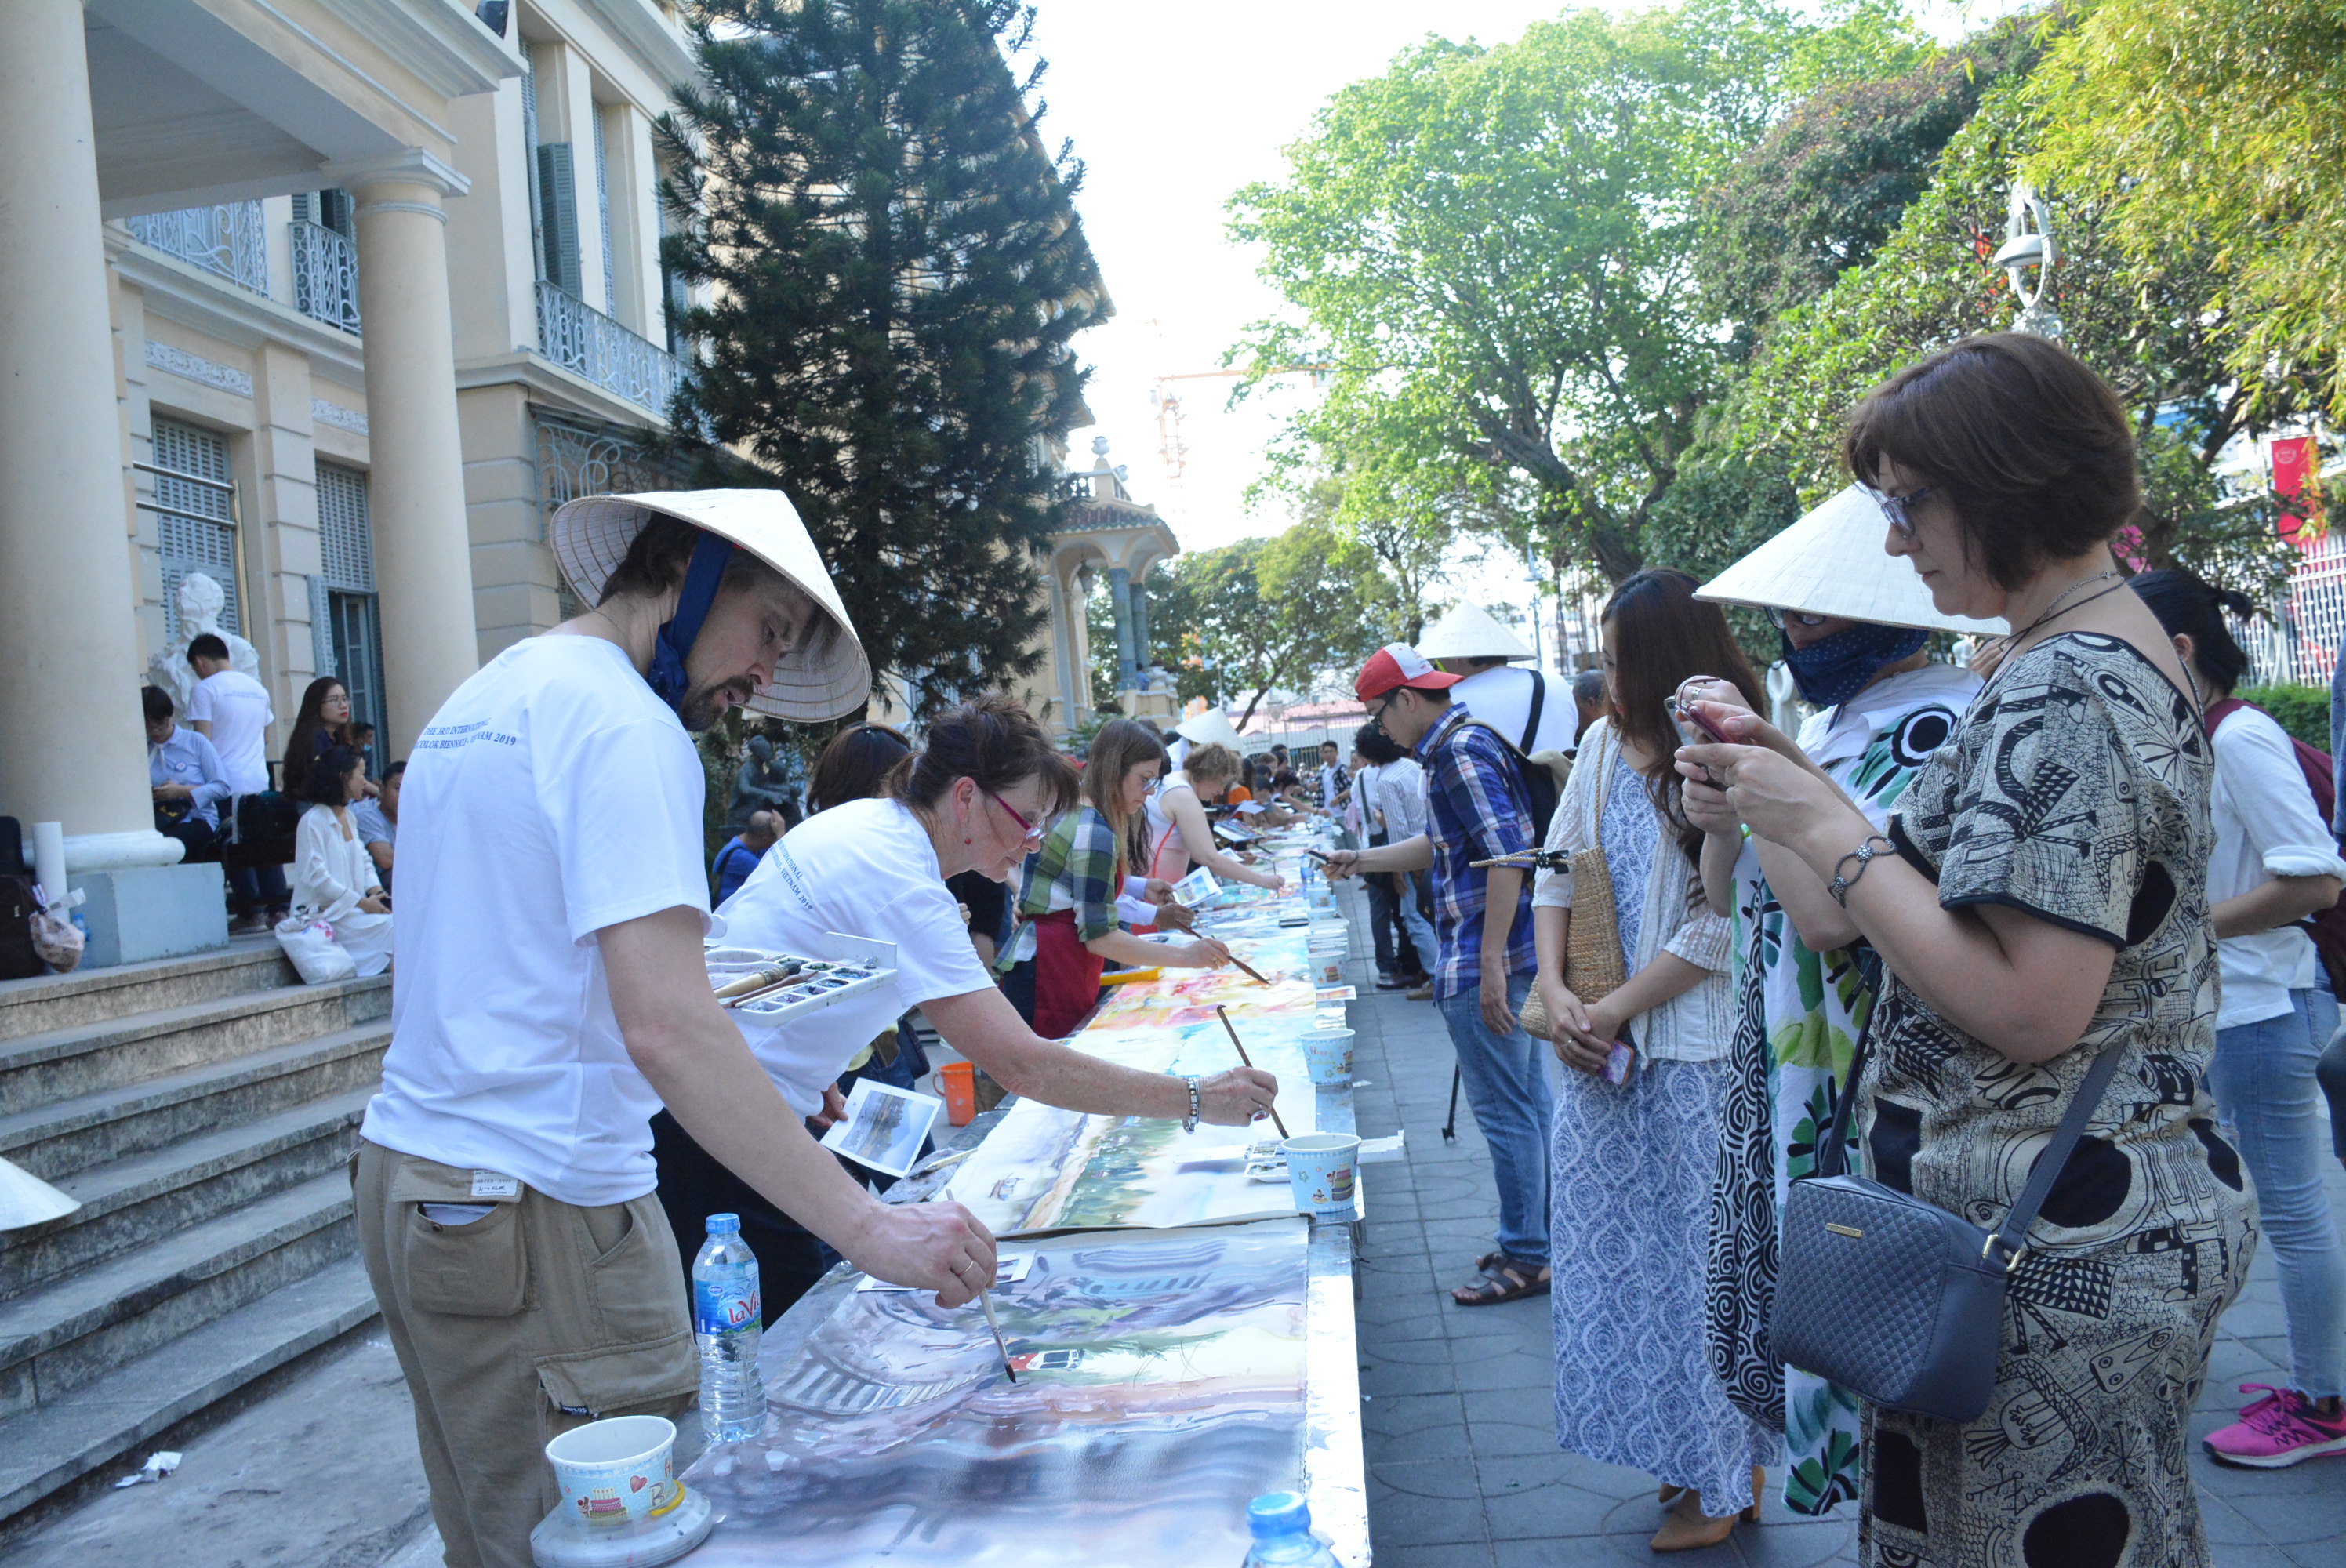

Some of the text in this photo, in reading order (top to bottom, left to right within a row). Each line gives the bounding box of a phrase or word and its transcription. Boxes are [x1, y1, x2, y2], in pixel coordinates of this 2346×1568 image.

[493, 733, 517, 746] 2019
[780, 867, 801, 896] VIETNAM
[798, 894, 813, 910] 2019
